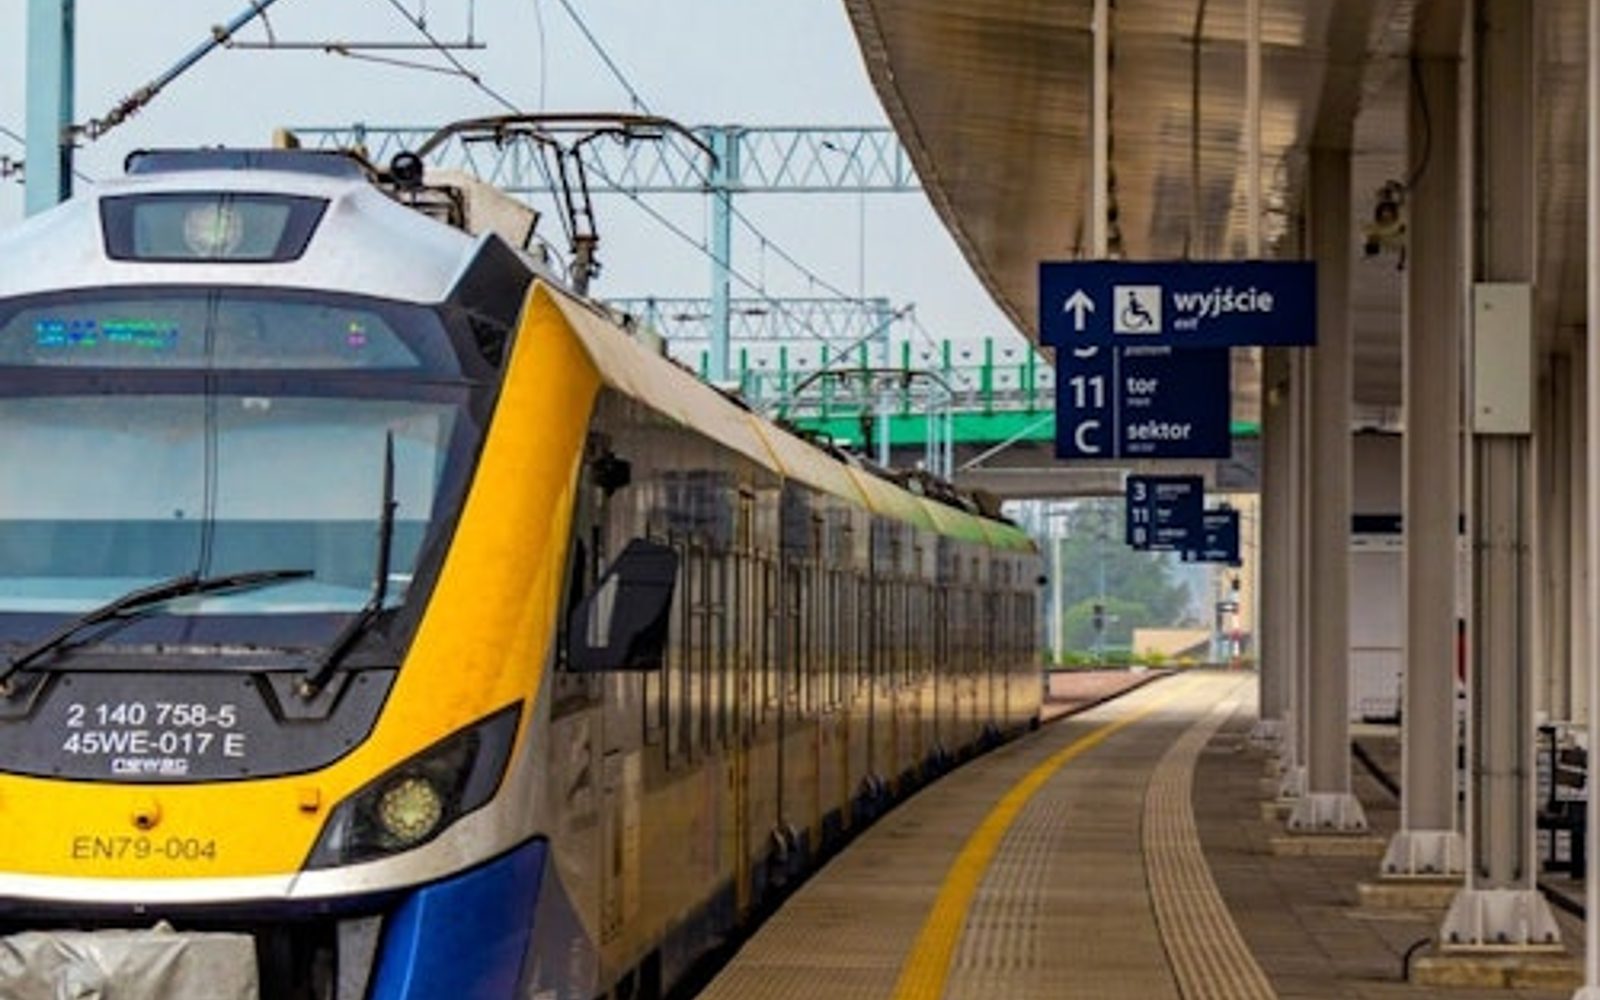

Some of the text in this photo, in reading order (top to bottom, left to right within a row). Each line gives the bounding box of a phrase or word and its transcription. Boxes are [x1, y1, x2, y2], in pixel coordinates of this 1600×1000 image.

[1173, 287, 1274, 317] wyjście
[1069, 375, 1158, 408] 11 tor
[1074, 420, 1191, 453] C sektor
[1133, 482, 1147, 501] 3
[66, 703, 236, 727] 2 140 758-5
[63, 731, 246, 757] 45WE-017 E
[71, 835, 218, 860] EN79-004
